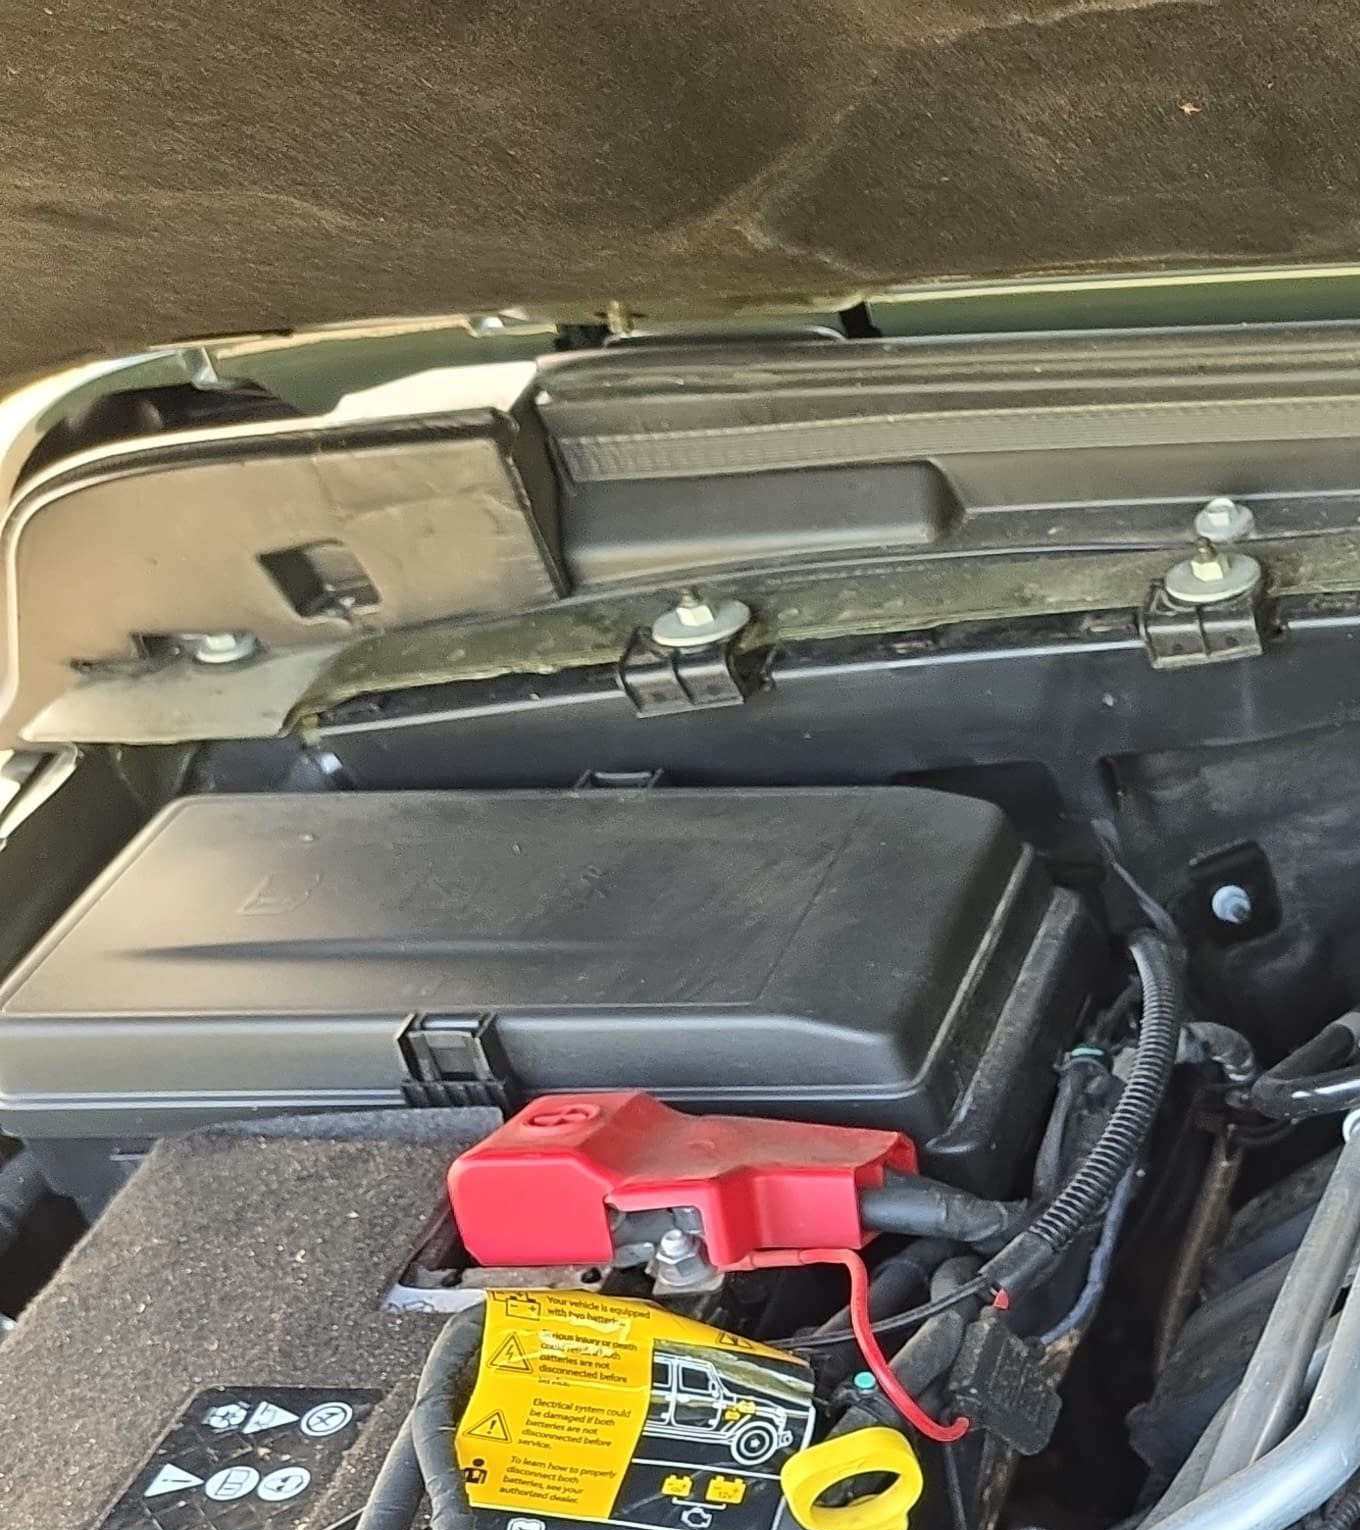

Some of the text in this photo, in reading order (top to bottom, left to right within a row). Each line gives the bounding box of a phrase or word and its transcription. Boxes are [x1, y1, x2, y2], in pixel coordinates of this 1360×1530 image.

[547, 1296, 650, 1319] Your vehicle is equipped
[548, 1308, 567, 1318] with
[575, 1334, 602, 1347] injury
[603, 1339, 611, 1347] or
[612, 1338, 637, 1351] death
[539, 1365, 628, 1383] disconnected before
[595, 1361, 610, 1370] not
[533, 1398, 631, 1418] Electrical system could
[525, 1418, 598, 1435] batteries are not
[529, 1409, 541, 1418] be
[543, 1411, 585, 1423] damaged
[594, 1415, 615, 1426] both
[518, 1438, 551, 1450] service.
[521, 1428, 612, 1447] disconnected before
[506, 1466, 579, 1485] disconnect both
[511, 1456, 617, 1480] To learn how to properly
[503, 1475, 584, 1496] batteries, see your
[499, 1486, 579, 1504] authorized dealer.
